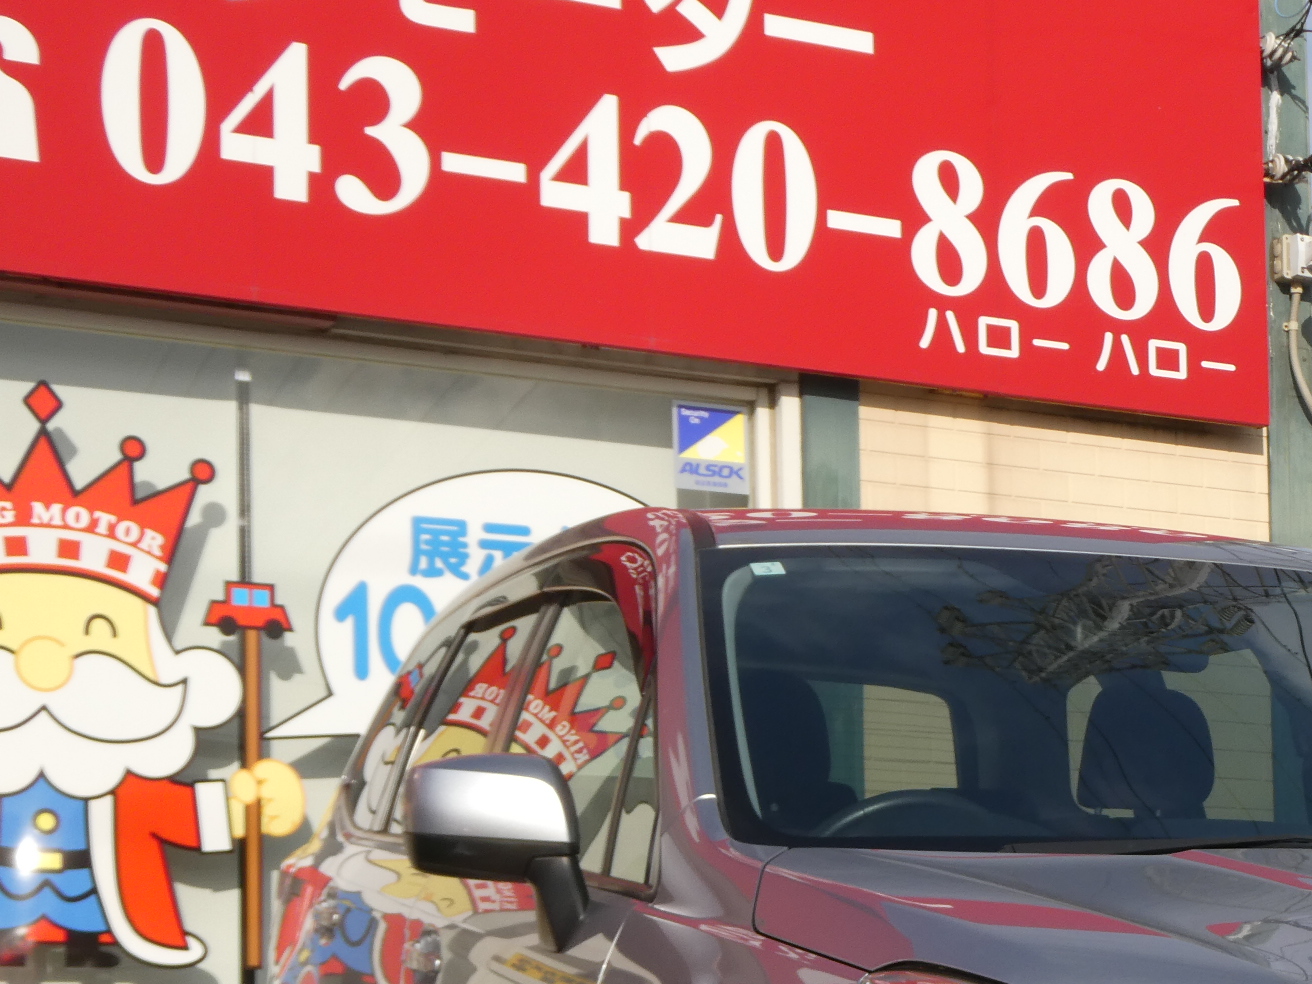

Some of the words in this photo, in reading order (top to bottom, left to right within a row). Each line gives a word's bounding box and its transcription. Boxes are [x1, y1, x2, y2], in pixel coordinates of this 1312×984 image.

[918, 307, 1070, 359] ハロー
[1096, 333, 1237, 380] ハロー
[679, 461, 745, 480] ALSOK
[29, 501, 165, 556] MOTOR
